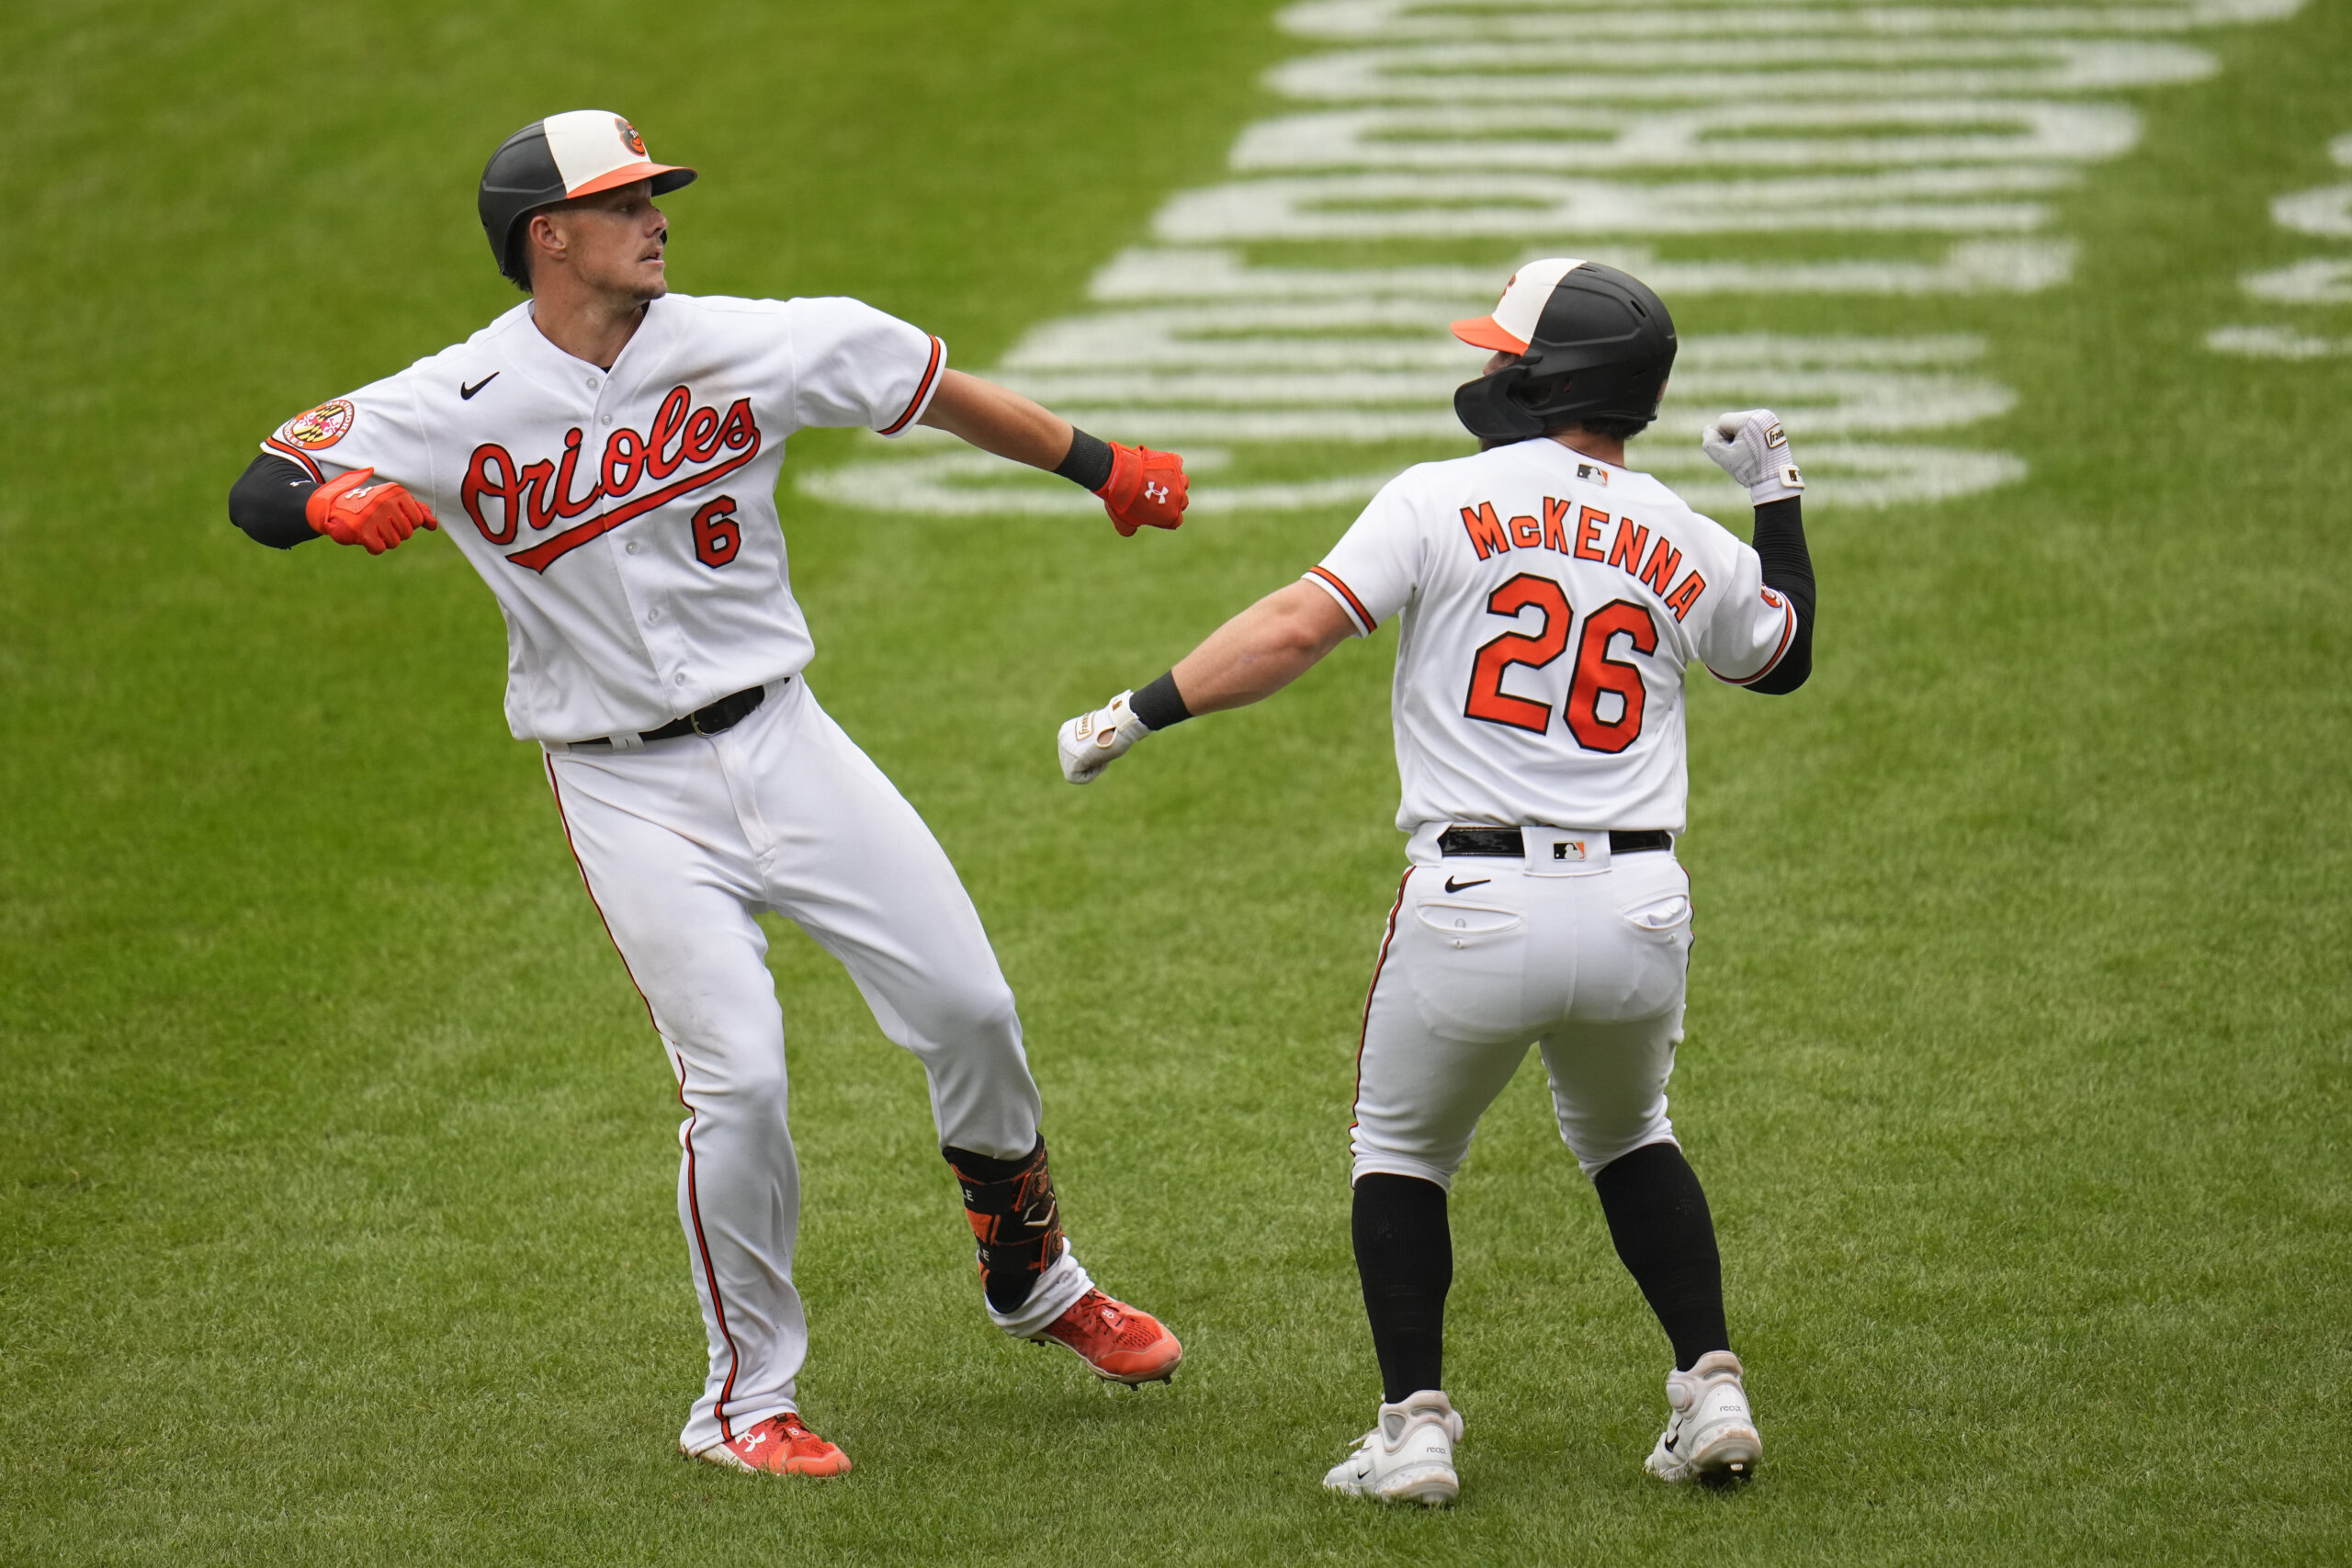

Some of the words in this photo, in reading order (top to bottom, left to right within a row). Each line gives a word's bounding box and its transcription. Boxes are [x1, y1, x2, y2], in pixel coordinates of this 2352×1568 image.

[325, 400, 354, 438] BALTIMORE
[461, 385, 761, 545] Orioles
[691, 494, 741, 569] 6
[1460, 496, 1707, 624] McKENNA
[1464, 571, 1659, 753] 26
